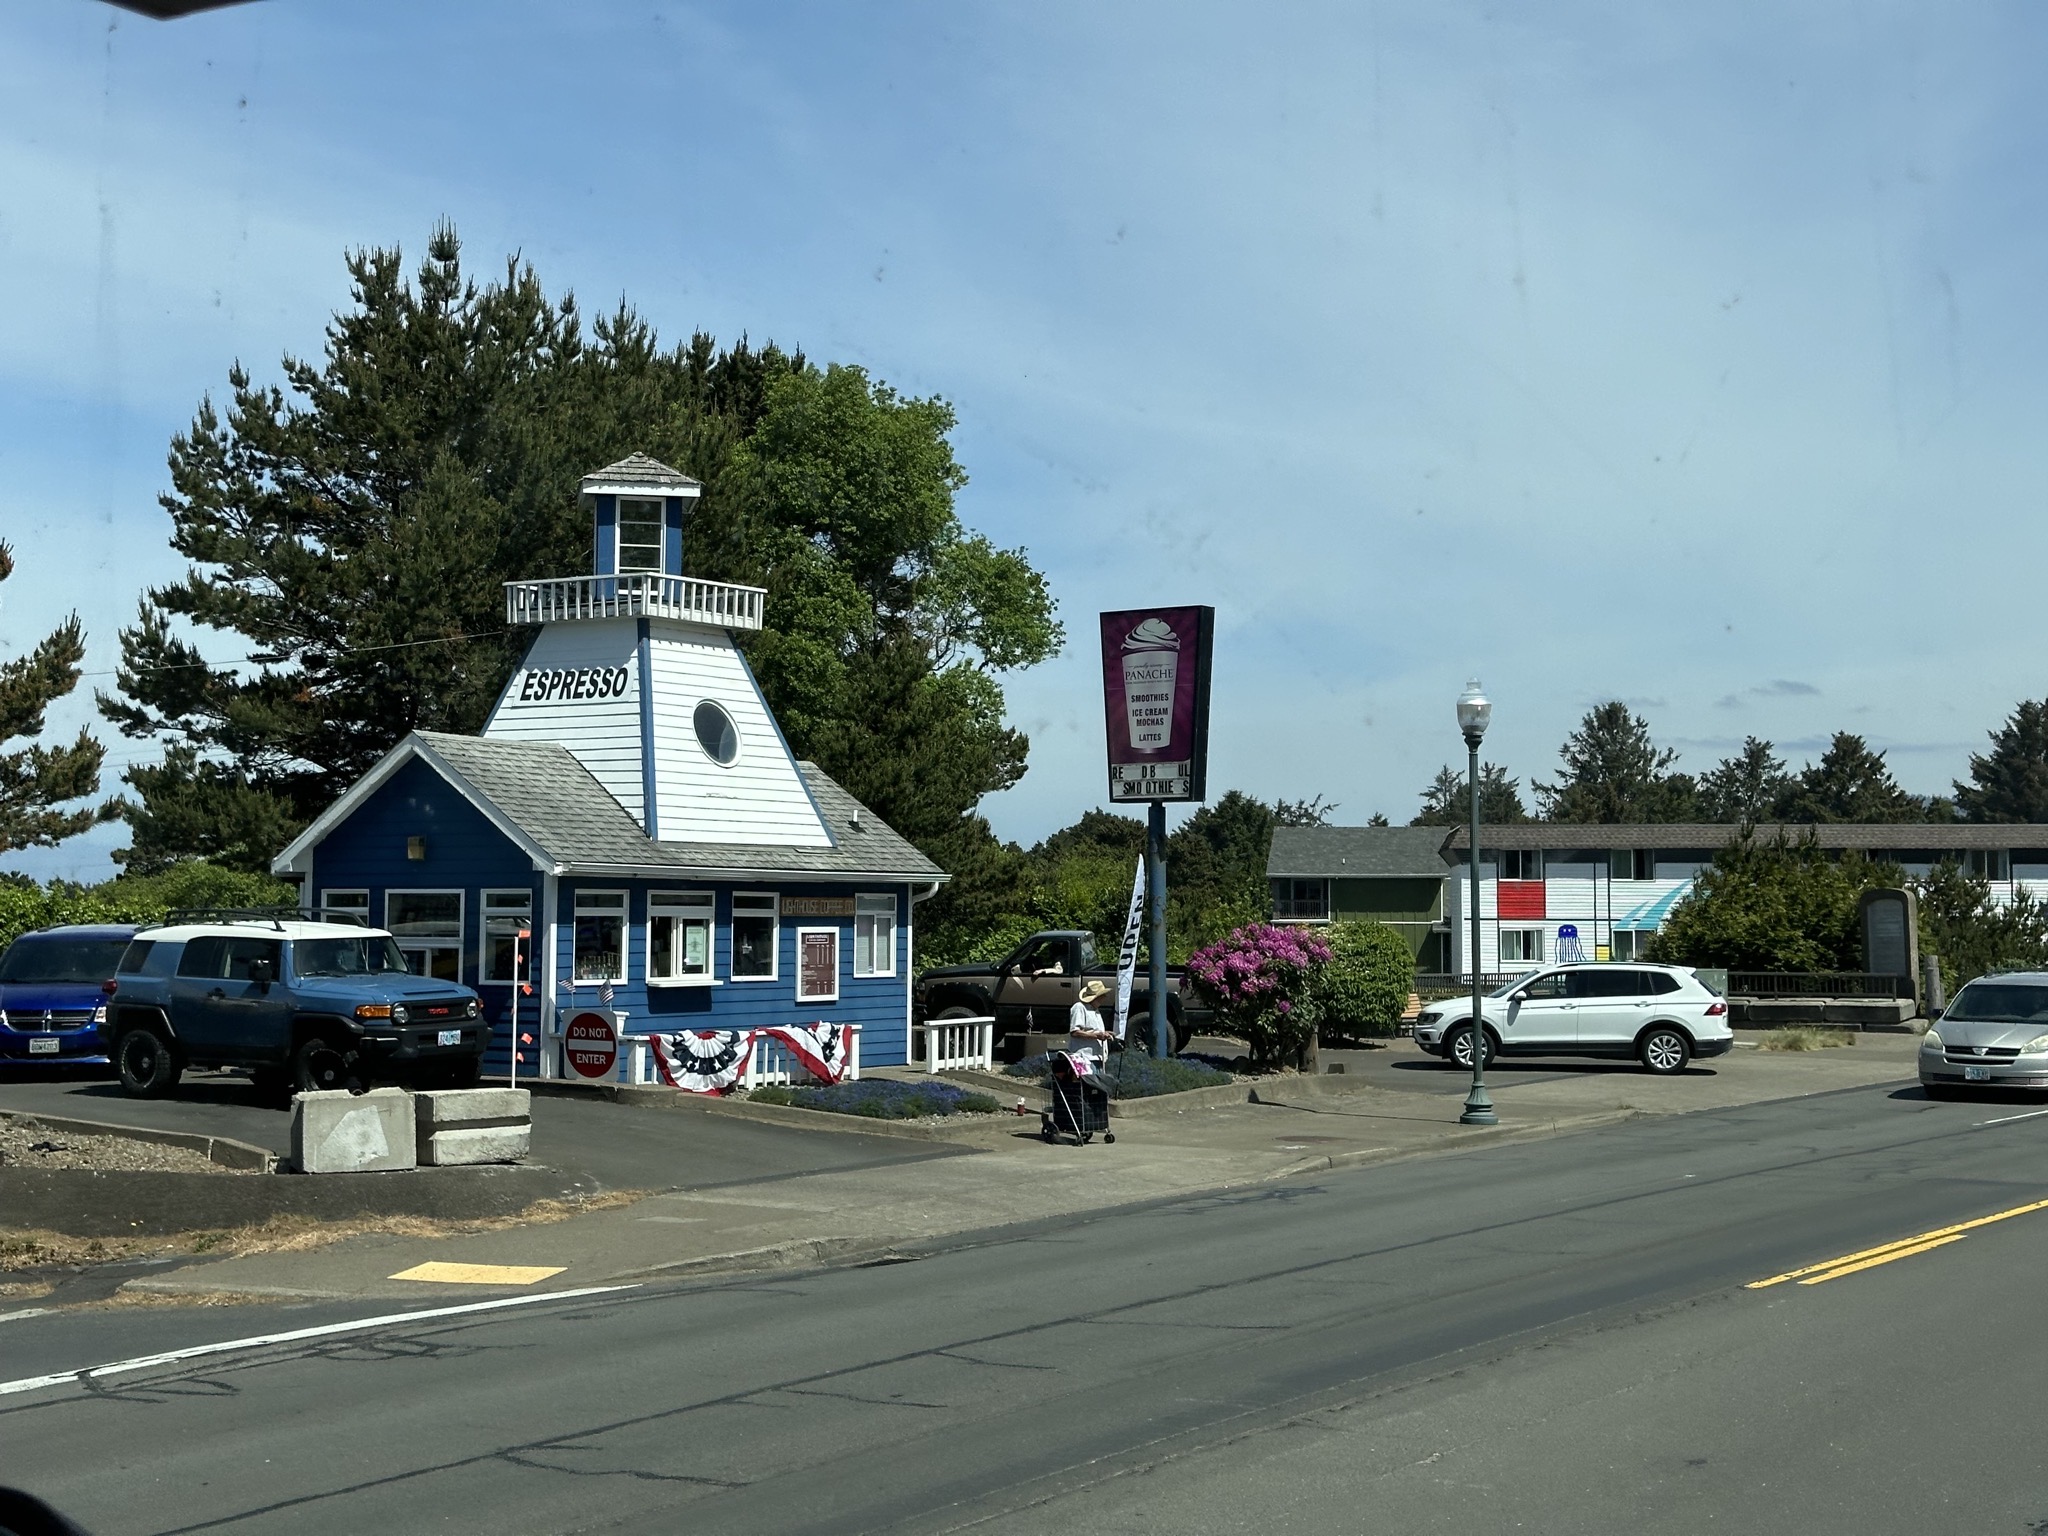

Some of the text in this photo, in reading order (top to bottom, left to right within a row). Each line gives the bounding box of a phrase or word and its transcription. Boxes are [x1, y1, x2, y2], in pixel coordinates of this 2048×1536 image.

[1125, 669, 1174, 681] PANACHE
[520, 667, 629, 701] ESPRESSO
[1131, 693, 1169, 703] SMOOTHIES
[1132, 707, 1168, 717] ICE CREAM
[1136, 718, 1164, 727] MOCHAS
[1139, 733, 1162, 742] LATTES
[427, 1007, 449, 1015] TOYOTA
[573, 1027, 607, 1038] DO NOT
[576, 1053, 606, 1064] ENTER
